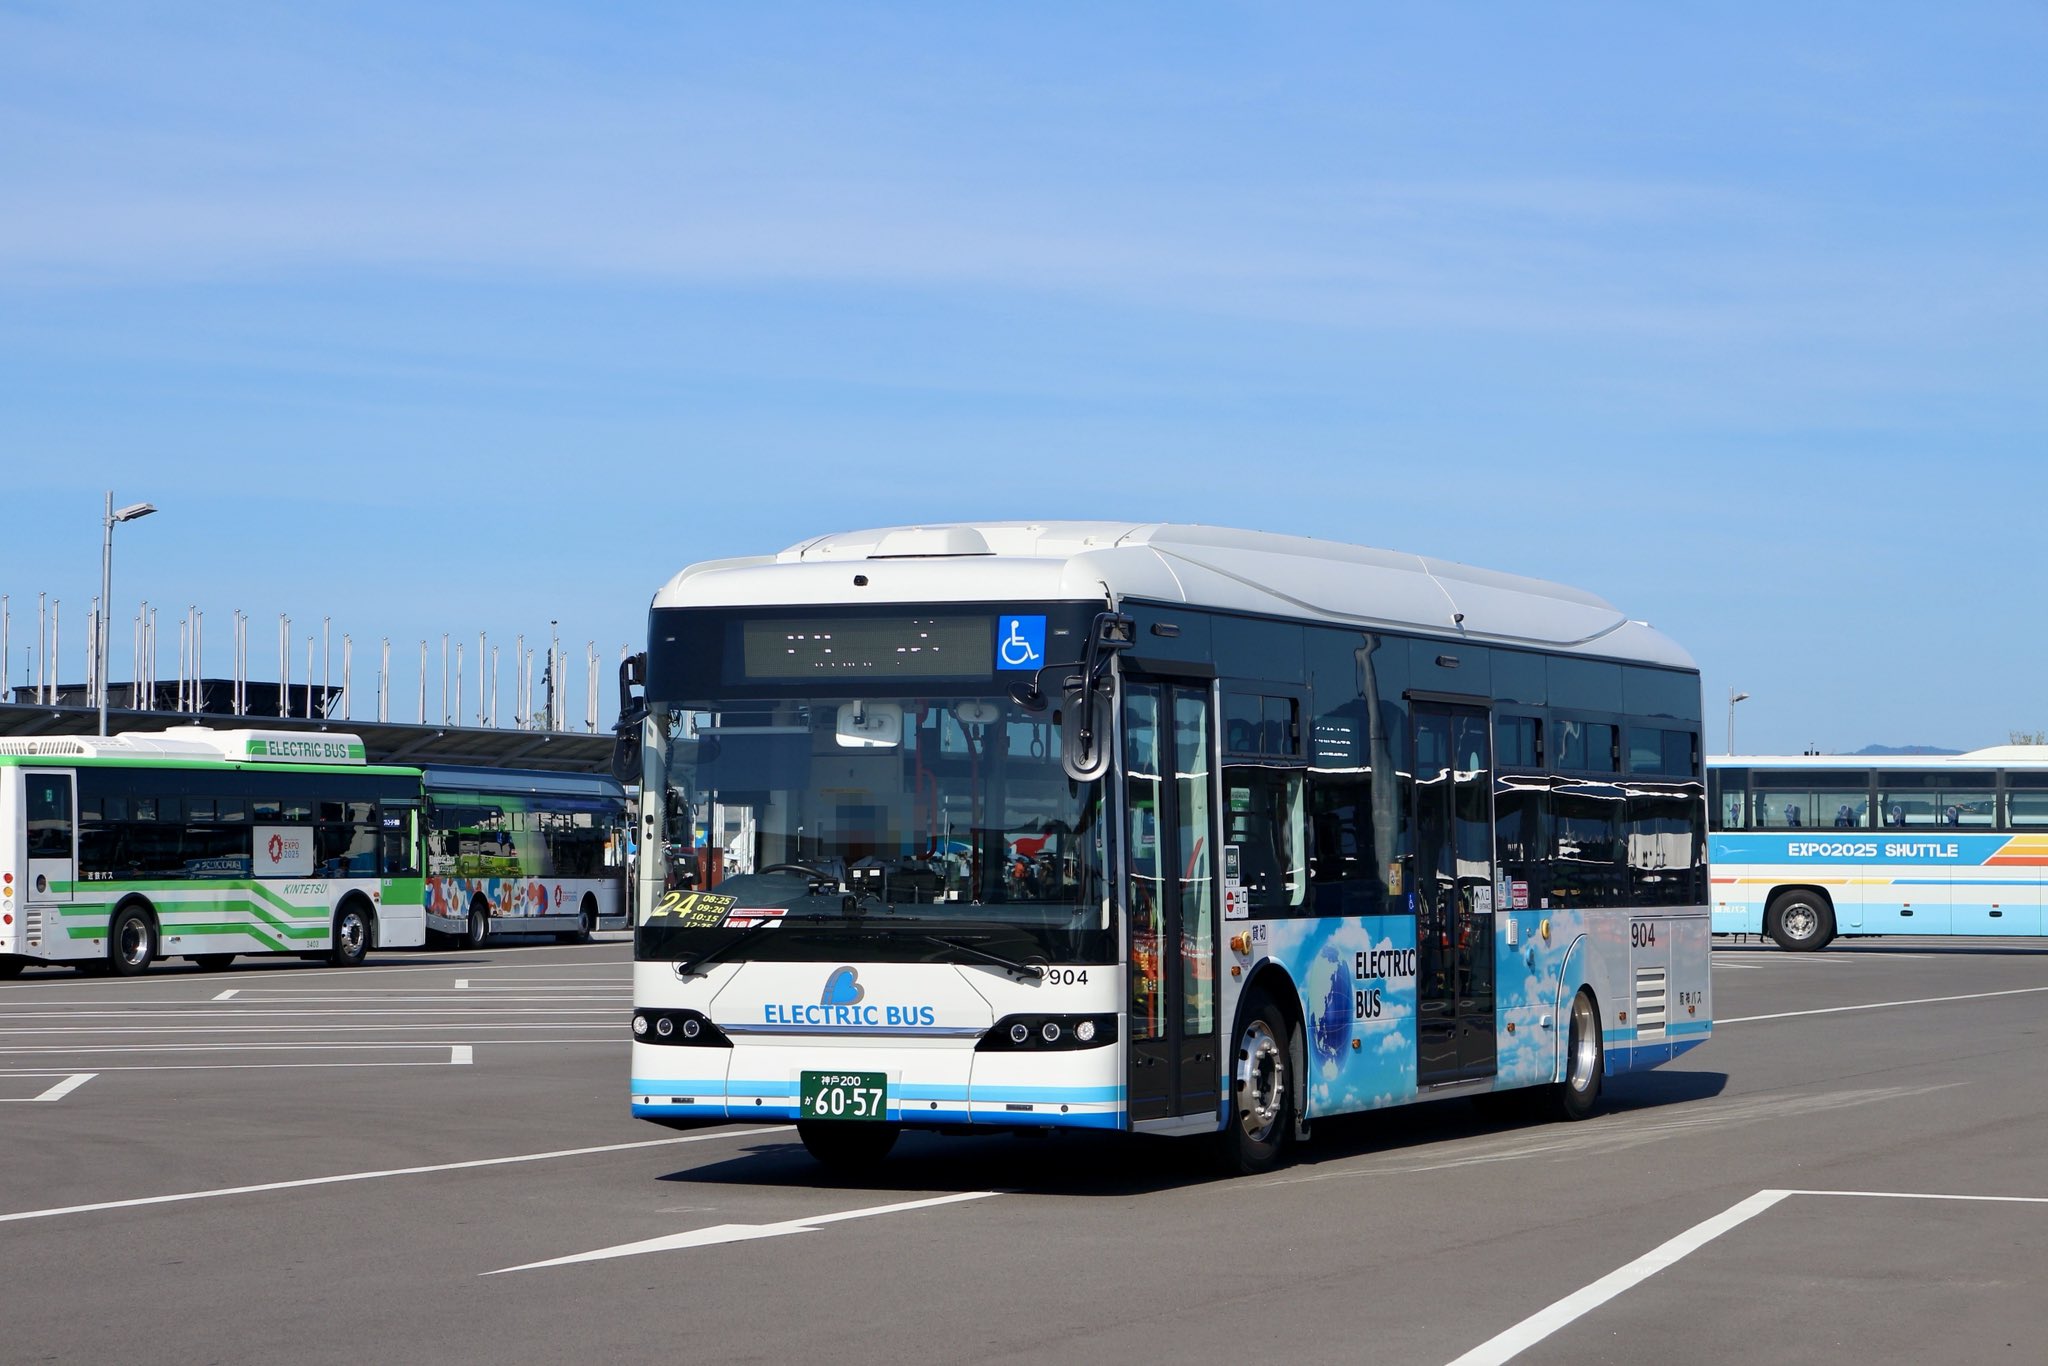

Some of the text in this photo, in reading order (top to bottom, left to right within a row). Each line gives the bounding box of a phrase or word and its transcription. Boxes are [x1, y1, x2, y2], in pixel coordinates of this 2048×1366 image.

[268, 740, 347, 759] ELECTRIC BUS
[284, 841, 300, 850] EXPO
[1788, 842, 1959, 858] EXPO2025 SHUTTLE
[284, 850, 300, 859] 2025
[283, 883, 328, 894] KINTETSU
[1480, 888, 1490, 901] 入口
[702, 894, 732, 905] 08:25
[1235, 890, 1247, 904] 出口
[652, 892, 700, 918] 24
[696, 903, 725, 914] 09:20
[1236, 906, 1247, 915] EXIT
[690, 912, 720, 923] 10:15
[1252, 924, 1266, 941] 貸切
[1631, 923, 1656, 948] 904
[1356, 948, 1416, 980] ELECTRIC
[1049, 969, 1089, 986] 904
[1356, 989, 1381, 1019] BUS
[1679, 991, 1702, 1006] 阪神バス
[764, 1004, 935, 1026] ELECTRIC BUS
[821, 1075, 862, 1087] 神戸200
[815, 1087, 884, 1117] 60-57
